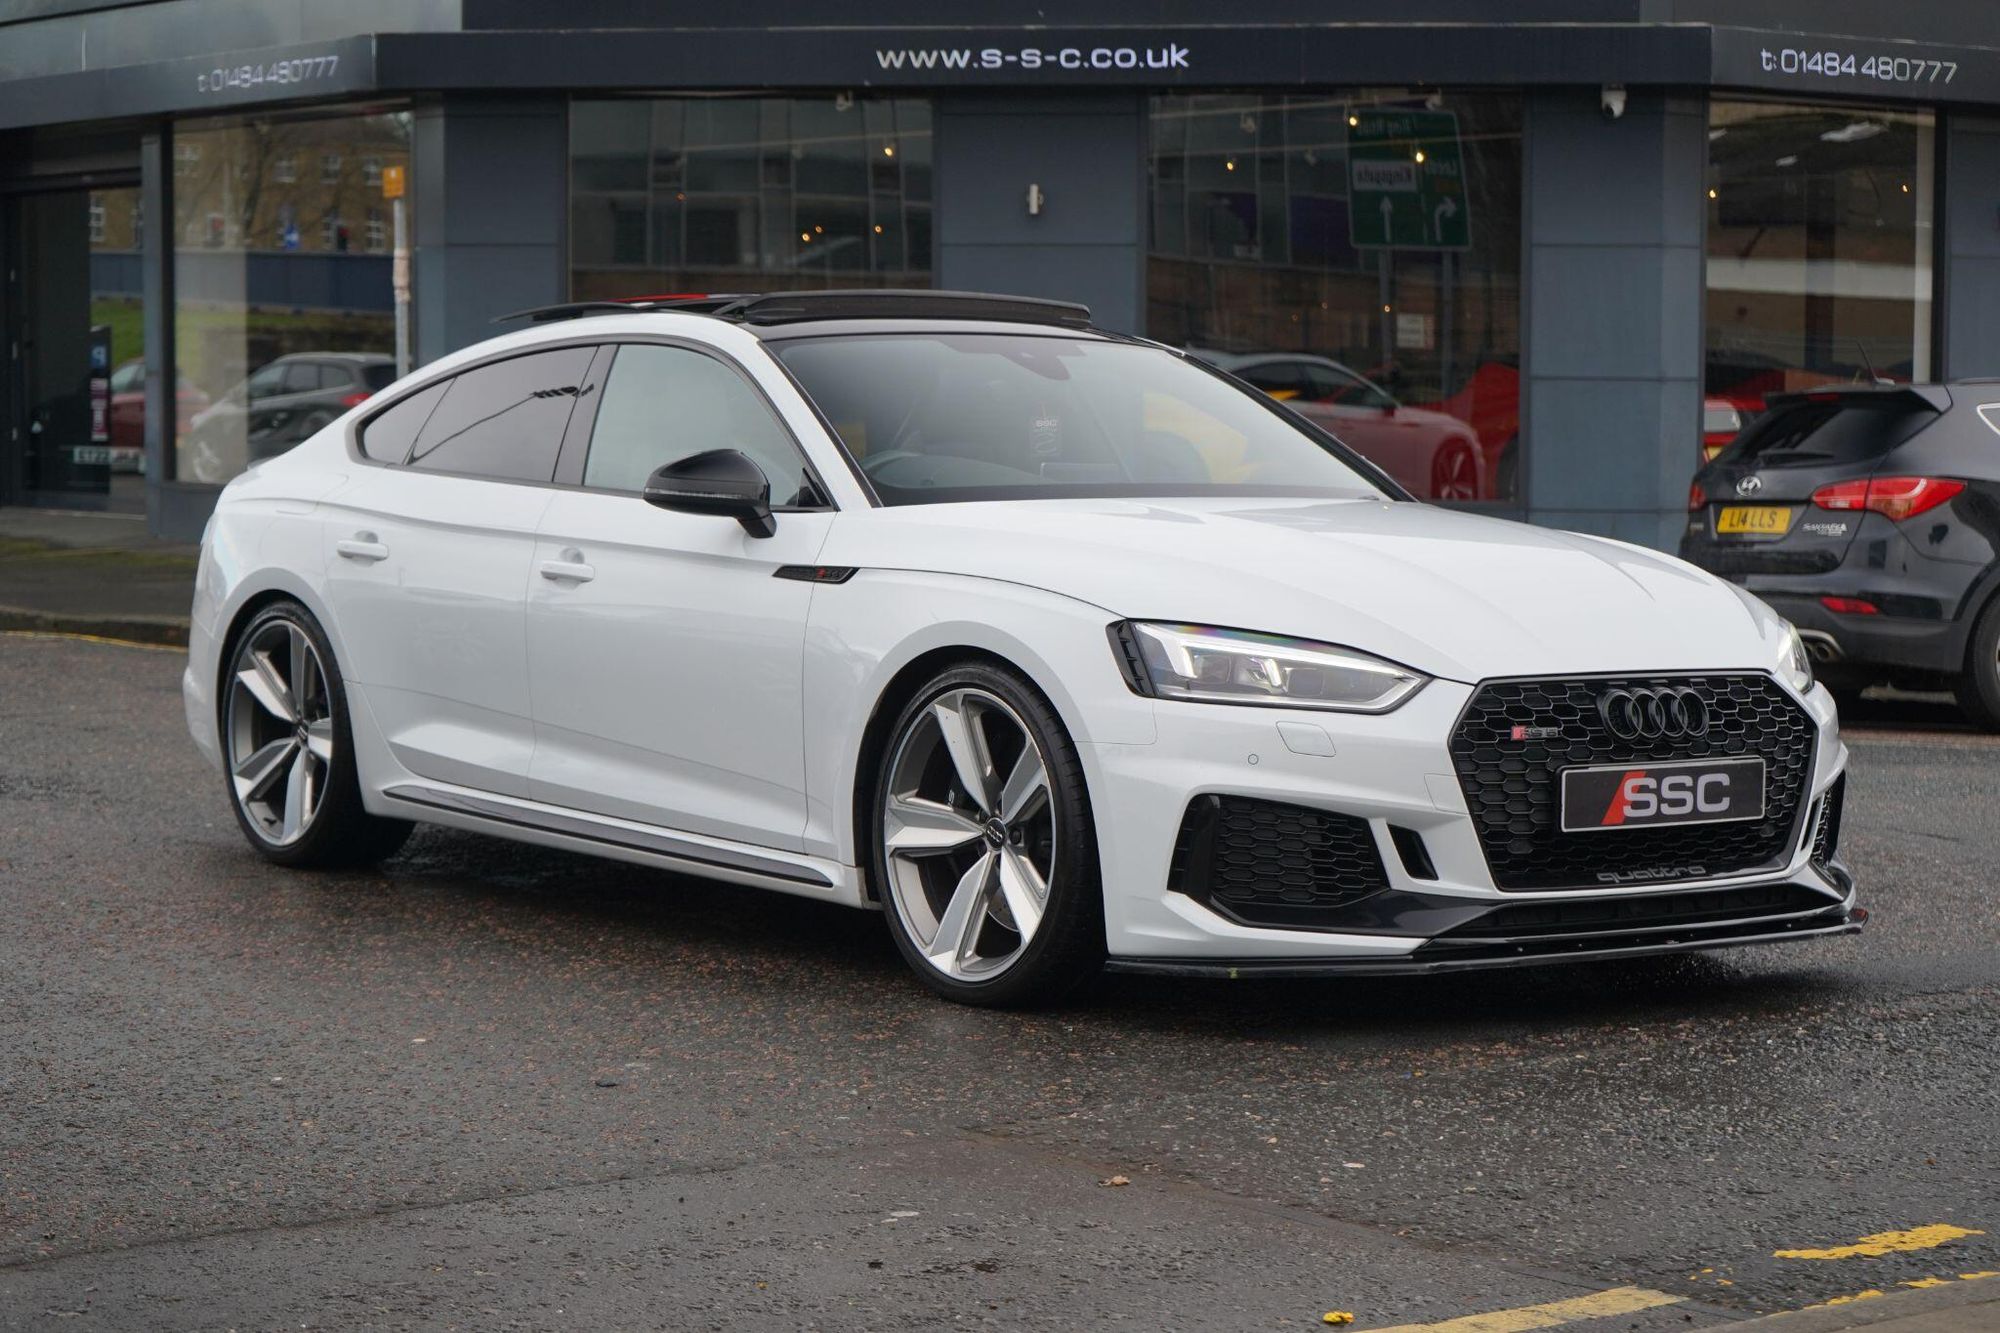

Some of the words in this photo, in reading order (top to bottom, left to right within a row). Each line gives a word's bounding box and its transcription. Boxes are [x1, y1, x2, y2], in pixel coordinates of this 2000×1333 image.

[265, 55, 339, 83] 480777
[876, 43, 1190, 69] www.s-s-c.co.uk
[1860, 55, 1958, 84] 480777
[1622, 773, 1730, 817] SSC
[1596, 864, 1706, 883] quattro
